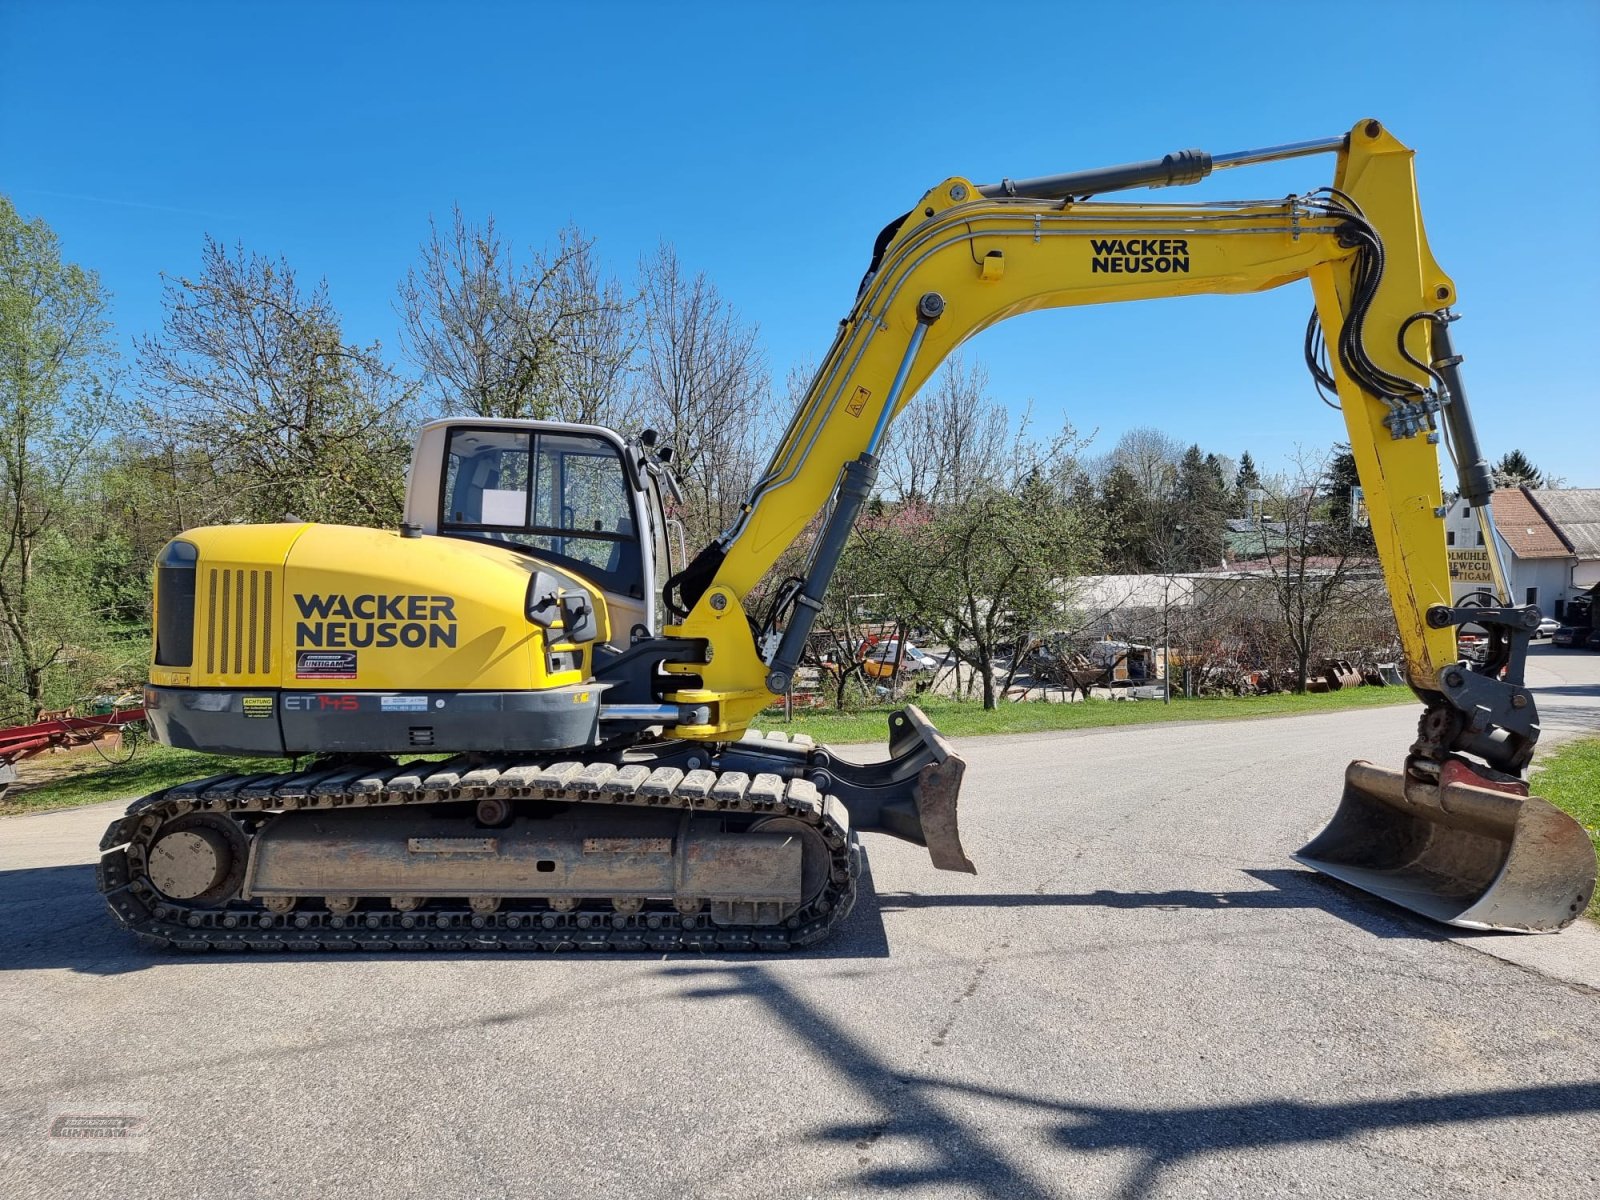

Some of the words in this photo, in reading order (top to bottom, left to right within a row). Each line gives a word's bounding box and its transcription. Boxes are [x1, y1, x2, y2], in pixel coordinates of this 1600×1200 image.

[1090, 239, 1189, 256] WACKER
[1092, 257, 1190, 273] NEUSON
[293, 594, 457, 621] WACKER
[296, 622, 457, 648] NEUSON
[285, 696, 316, 710] ET
[319, 695, 360, 711] 145
